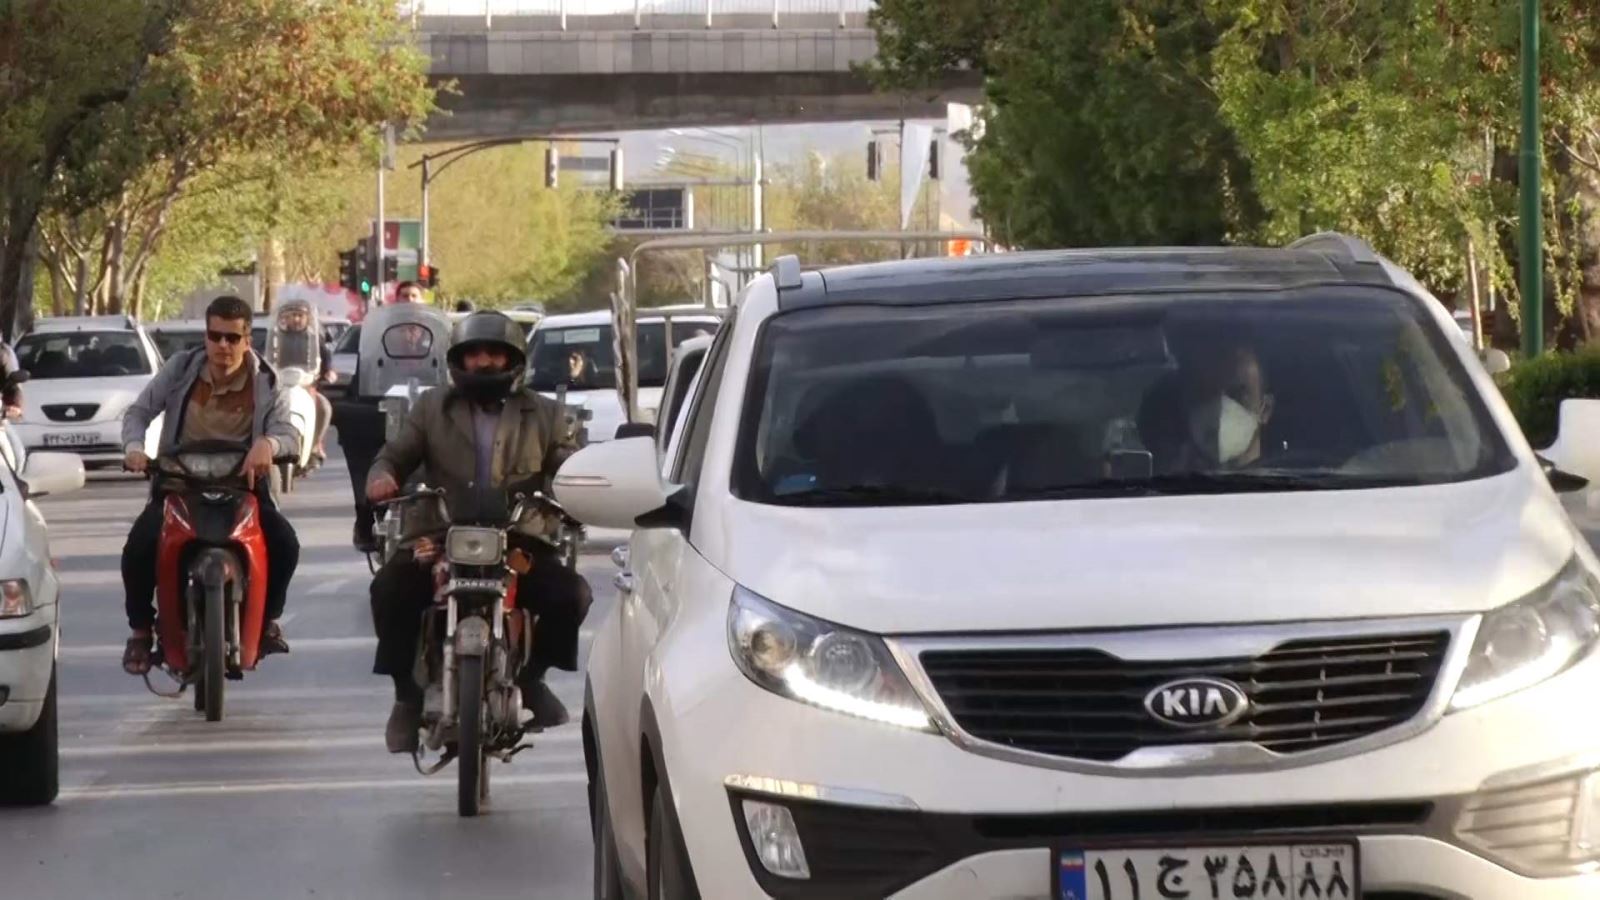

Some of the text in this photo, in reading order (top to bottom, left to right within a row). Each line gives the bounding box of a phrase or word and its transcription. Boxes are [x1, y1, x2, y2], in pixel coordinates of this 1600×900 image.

[1162, 688, 1229, 716] KIA
[1094, 857, 1140, 900] ۱۱
[1157, 855, 1191, 899] ج
[1299, 860, 1349, 899] ۸۸
